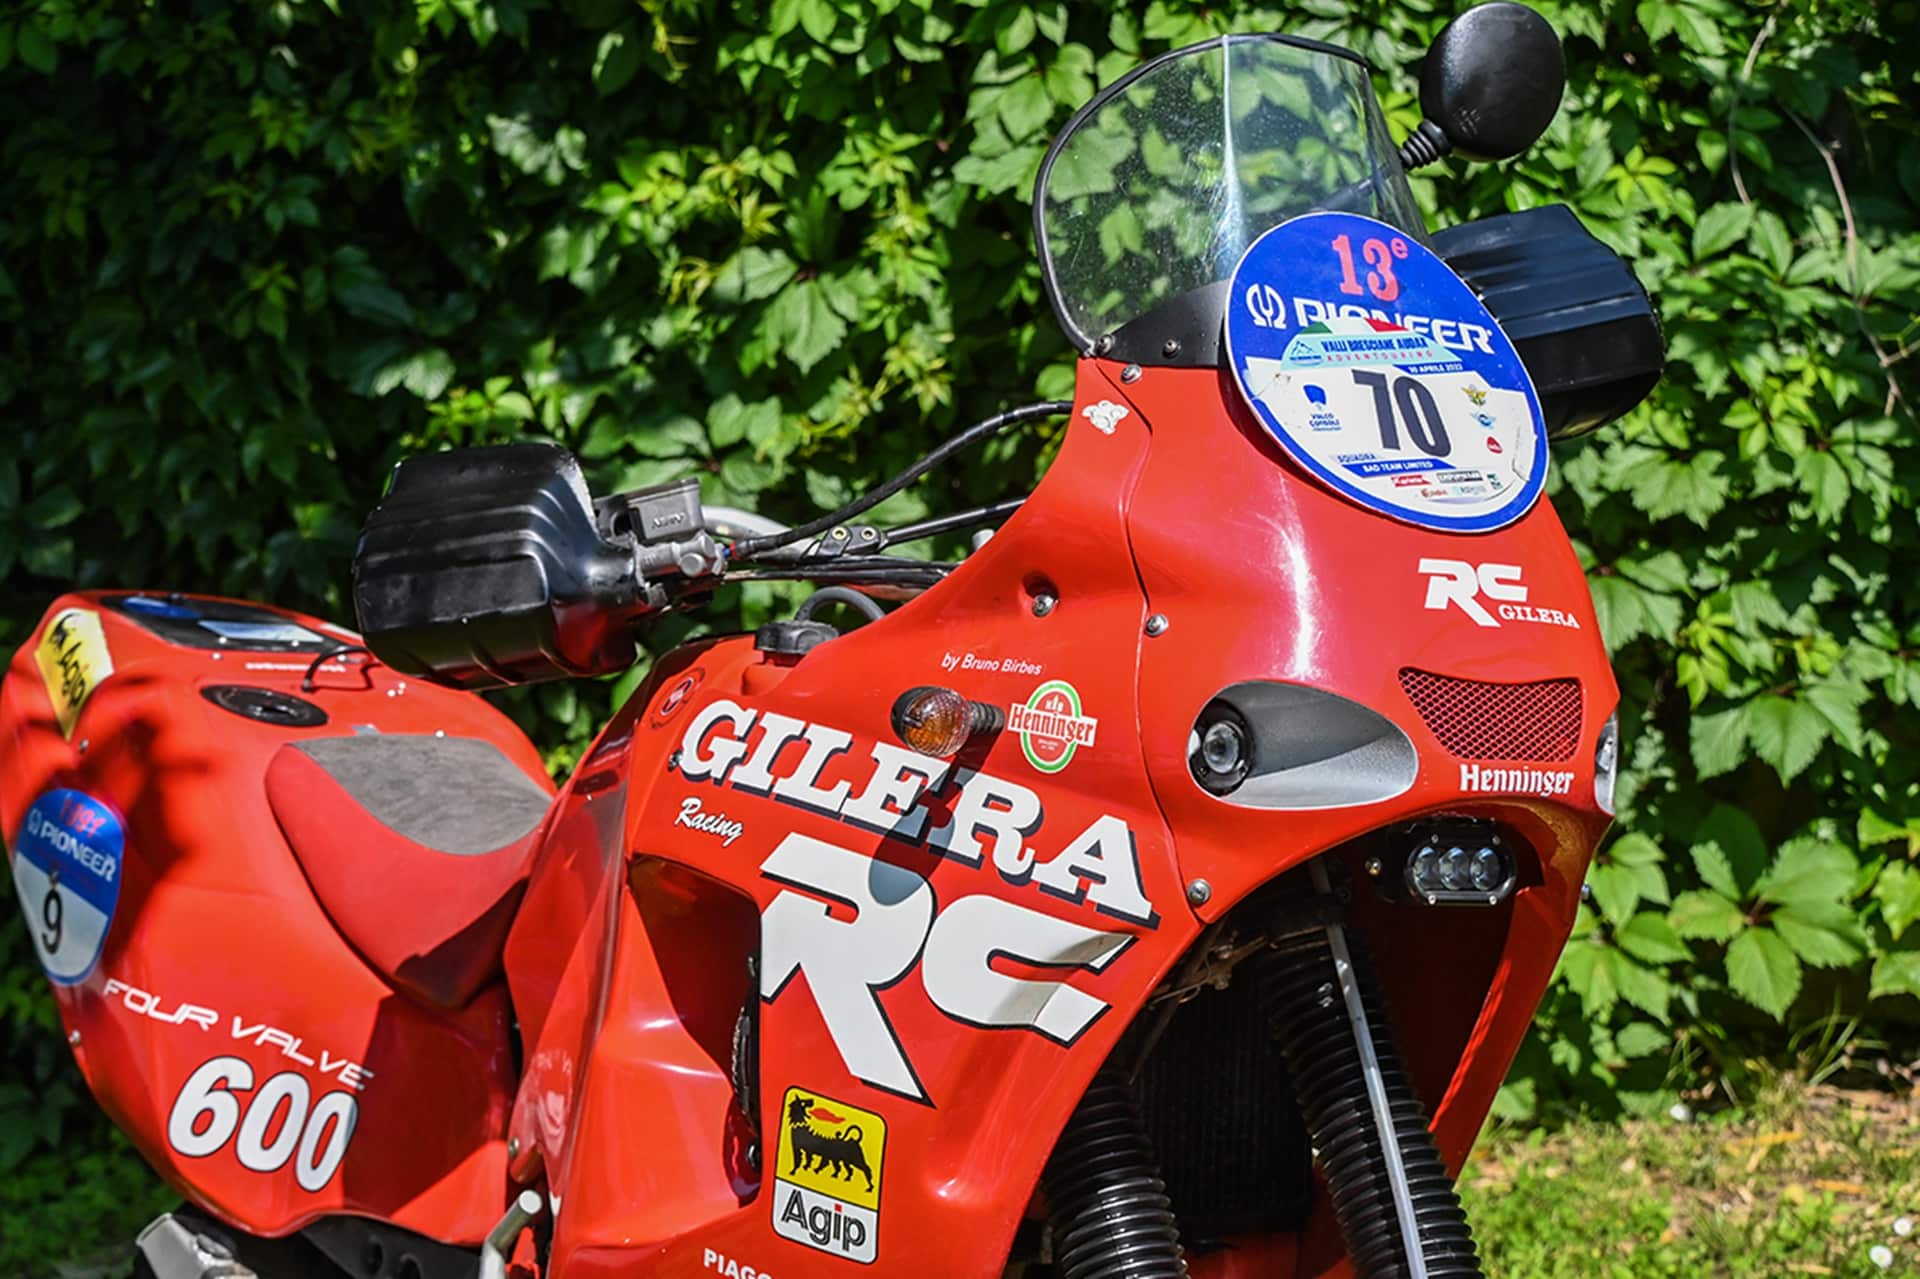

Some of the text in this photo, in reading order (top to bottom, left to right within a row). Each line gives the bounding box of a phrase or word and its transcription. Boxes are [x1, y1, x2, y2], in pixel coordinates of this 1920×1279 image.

[1321, 339, 1348, 352] VALLI
[1348, 338, 1396, 352] BRESCIANE
[1327, 350, 1433, 362] ADVENTOURING
[1351, 368, 1451, 458] 70
[1381, 462, 1403, 472] TEAM
[1403, 460, 1434, 470] LIMITED
[1418, 558, 1529, 627] RC
[1498, 604, 1580, 629] GILERA
[941, 651, 1042, 675] by Bruno Birbes
[1011, 706, 1094, 742] Henninger
[1459, 763, 1575, 796] Henninger
[674, 797, 744, 848] Racing
[681, 699, 1158, 930] GILERA
[40, 820, 117, 883] PIONEER
[42, 887, 63, 956] 9
[759, 832, 1137, 1107] RC
[104, 978, 375, 1092] FOUR VALVE
[168, 1055, 359, 1192] 600
[781, 1189, 866, 1252] Agip
